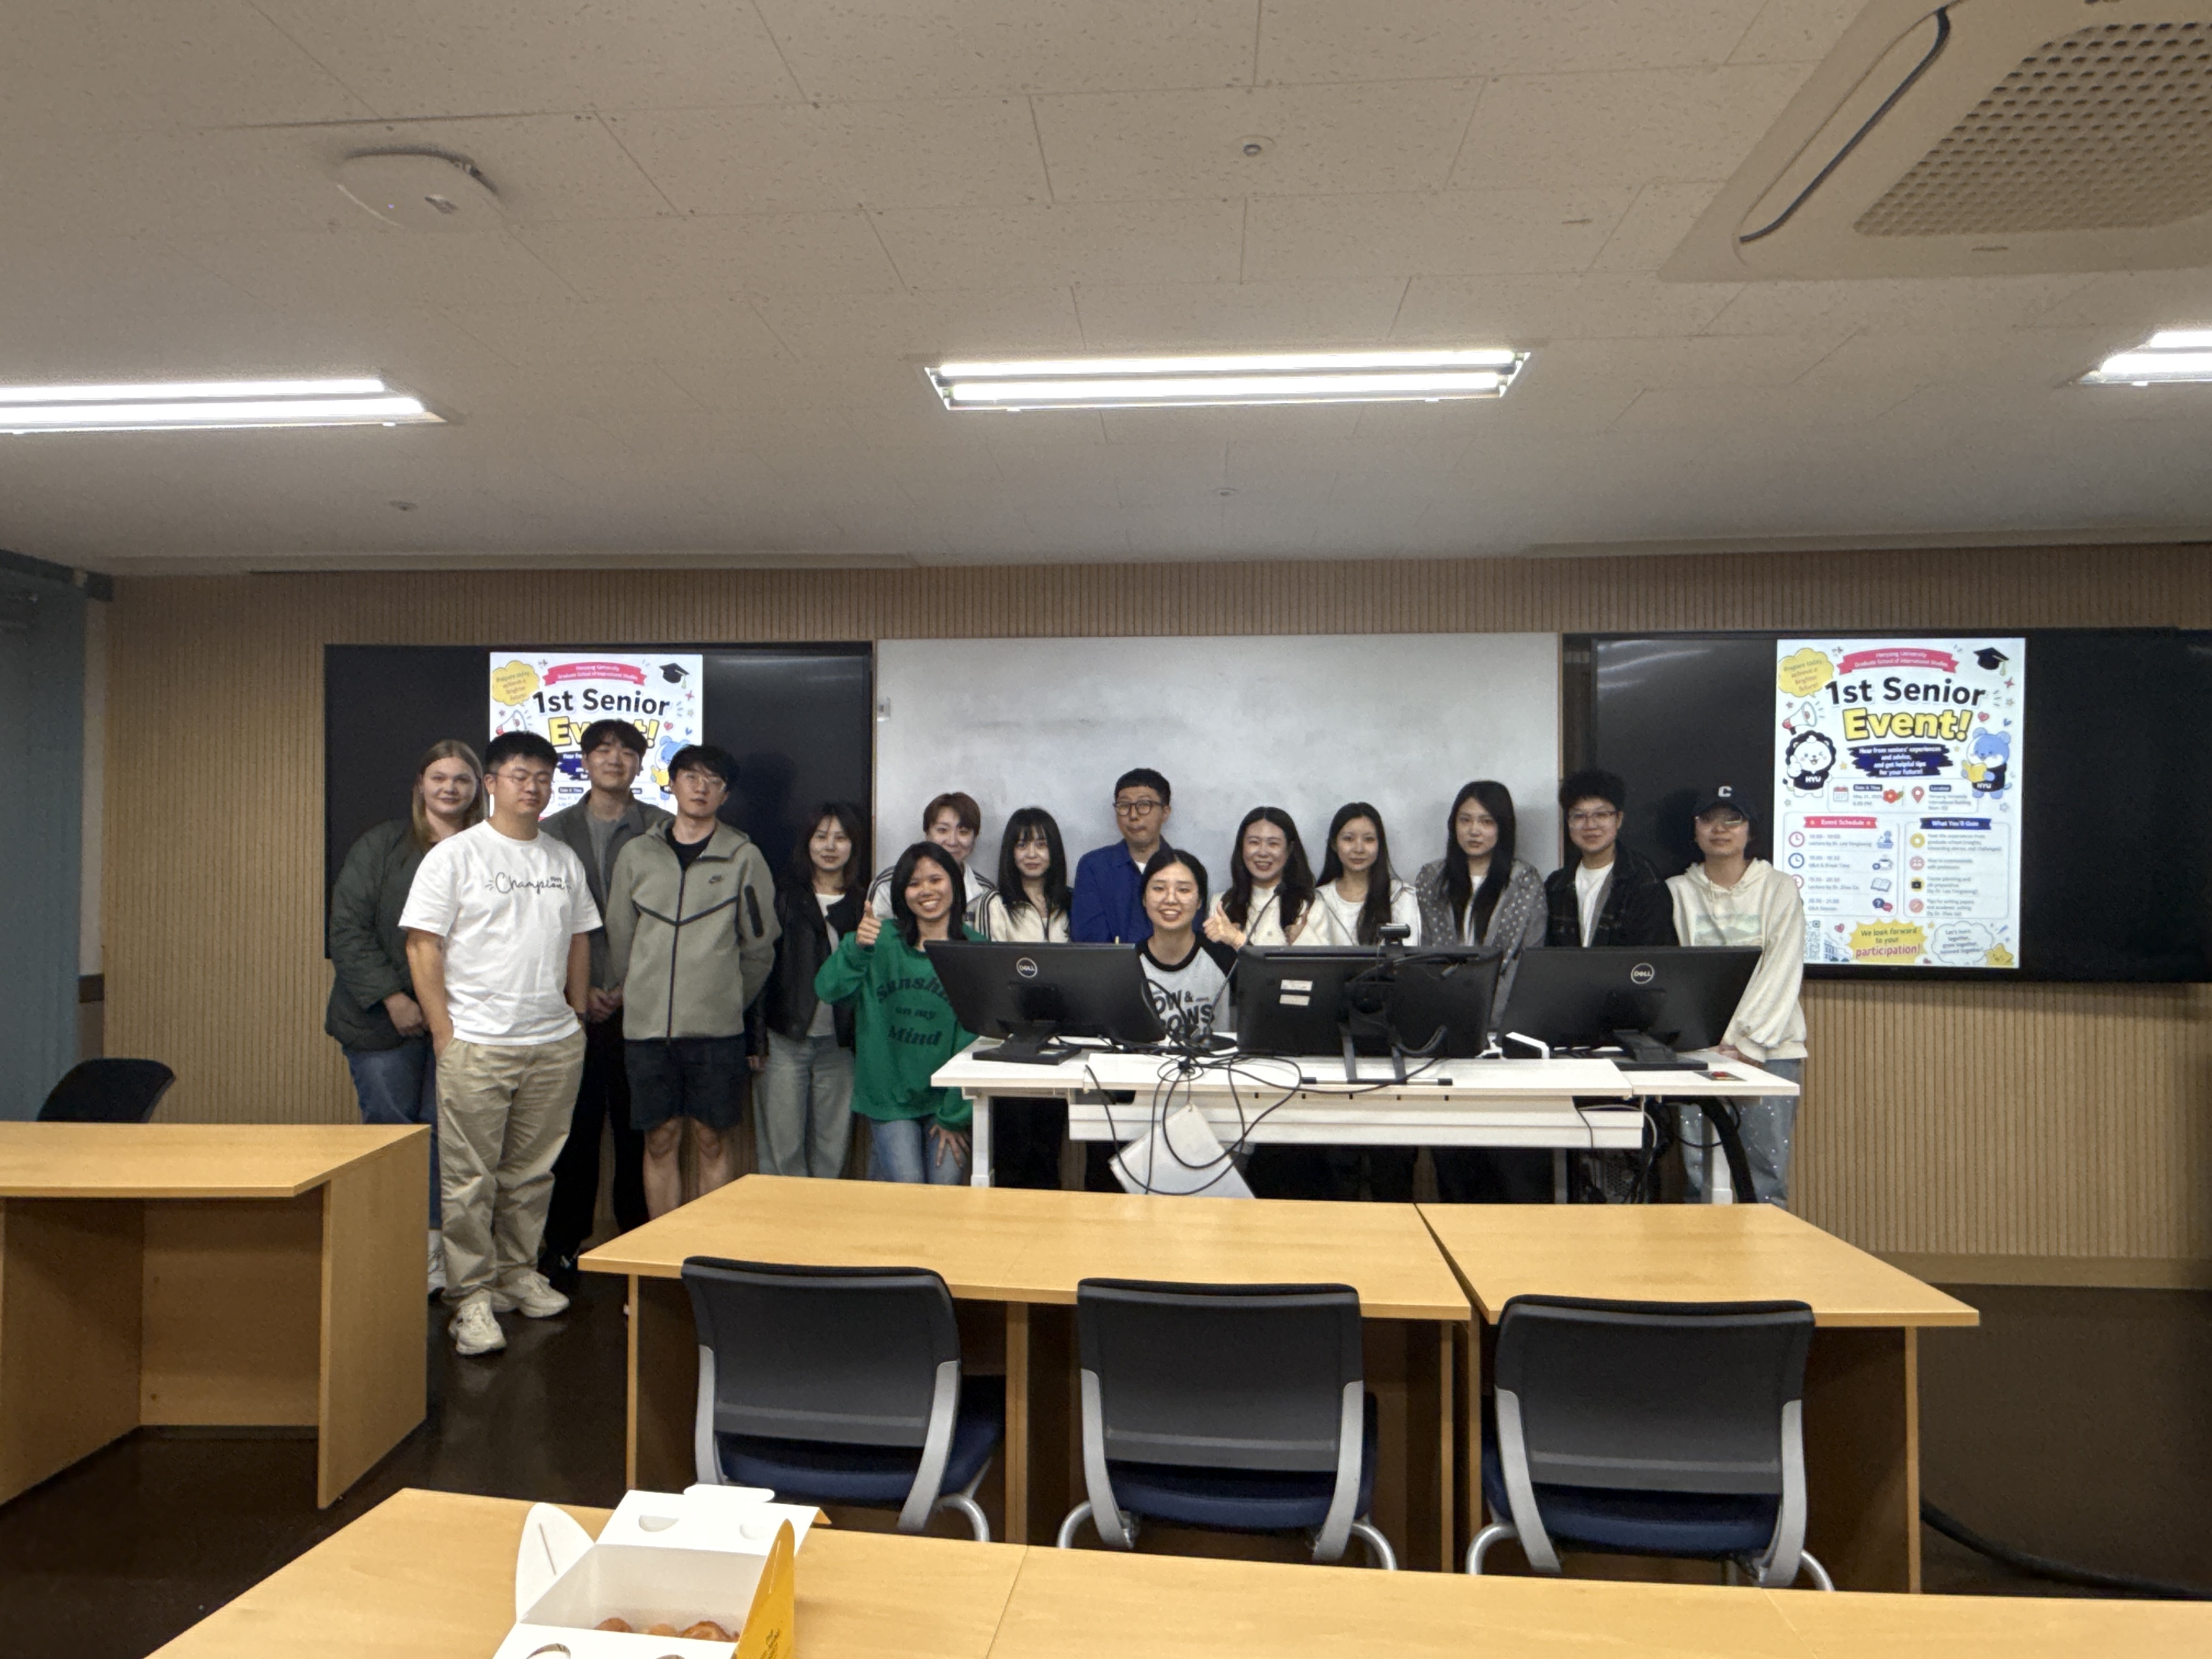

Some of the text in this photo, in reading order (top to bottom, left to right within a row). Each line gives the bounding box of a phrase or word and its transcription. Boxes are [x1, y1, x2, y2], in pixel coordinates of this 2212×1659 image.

[532, 688, 670, 716] 1st Senior
[1825, 676, 1986, 706] 1st Senior
[548, 716, 660, 748] Evt!
[1842, 707, 1973, 742] Event!
[1718, 786, 1733, 798] C
[495, 872, 566, 895] Champion
[1873, 928, 1888, 936] look
[1855, 943, 1921, 958] participation!
[1152, 989, 1193, 1014] OW &
[887, 1025, 943, 1046] Mind
